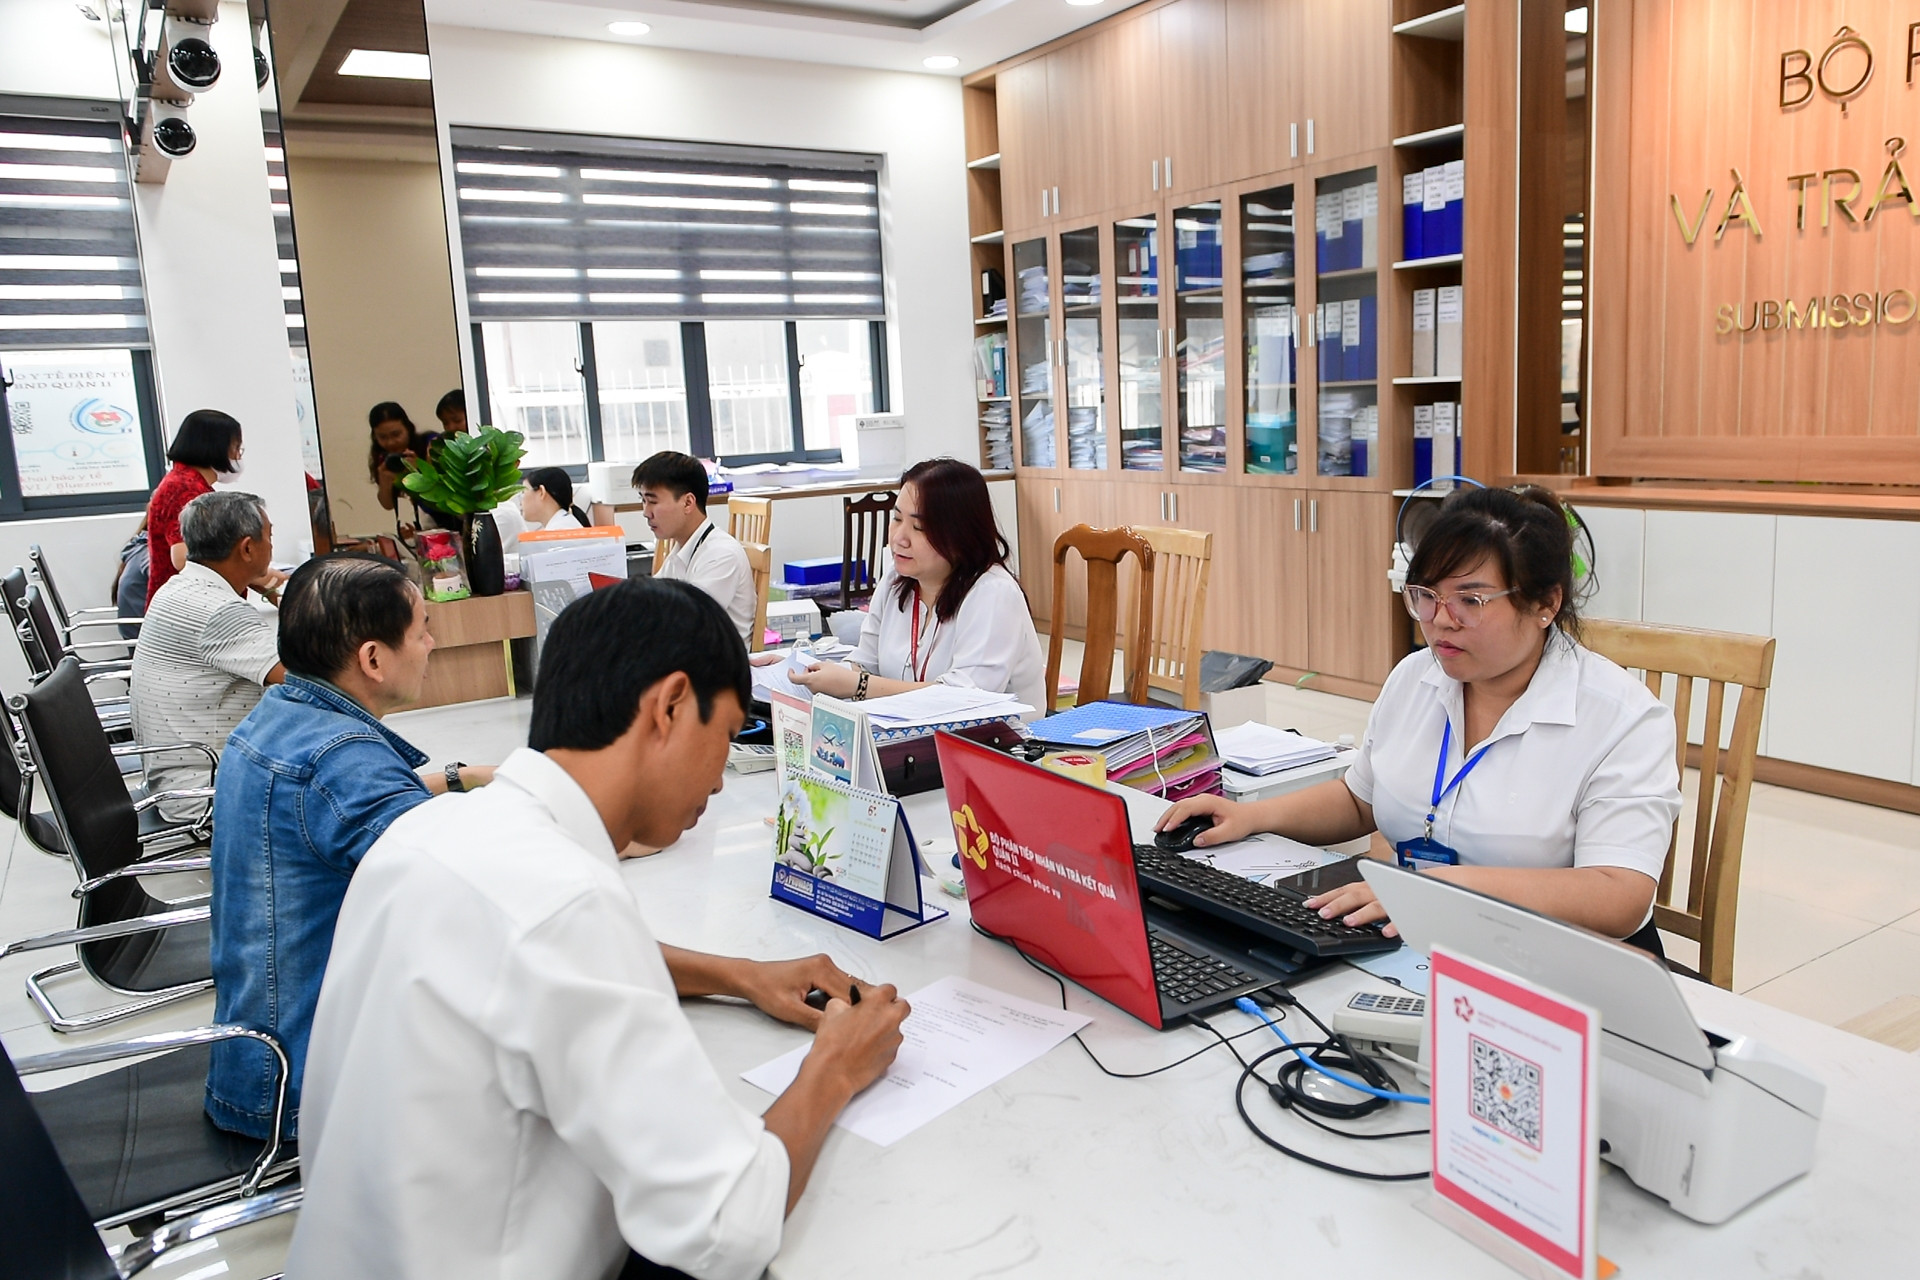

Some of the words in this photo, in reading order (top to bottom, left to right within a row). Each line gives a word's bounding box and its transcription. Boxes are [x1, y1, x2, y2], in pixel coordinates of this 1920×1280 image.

[1779, 25, 1873, 112] BỘ
[1670, 168, 1763, 244] VÀ
[1787, 136, 1920, 230] TRẢ
[1716, 290, 1920, 335] SUBMISSIO
[989, 831, 1000, 845] BỘ
